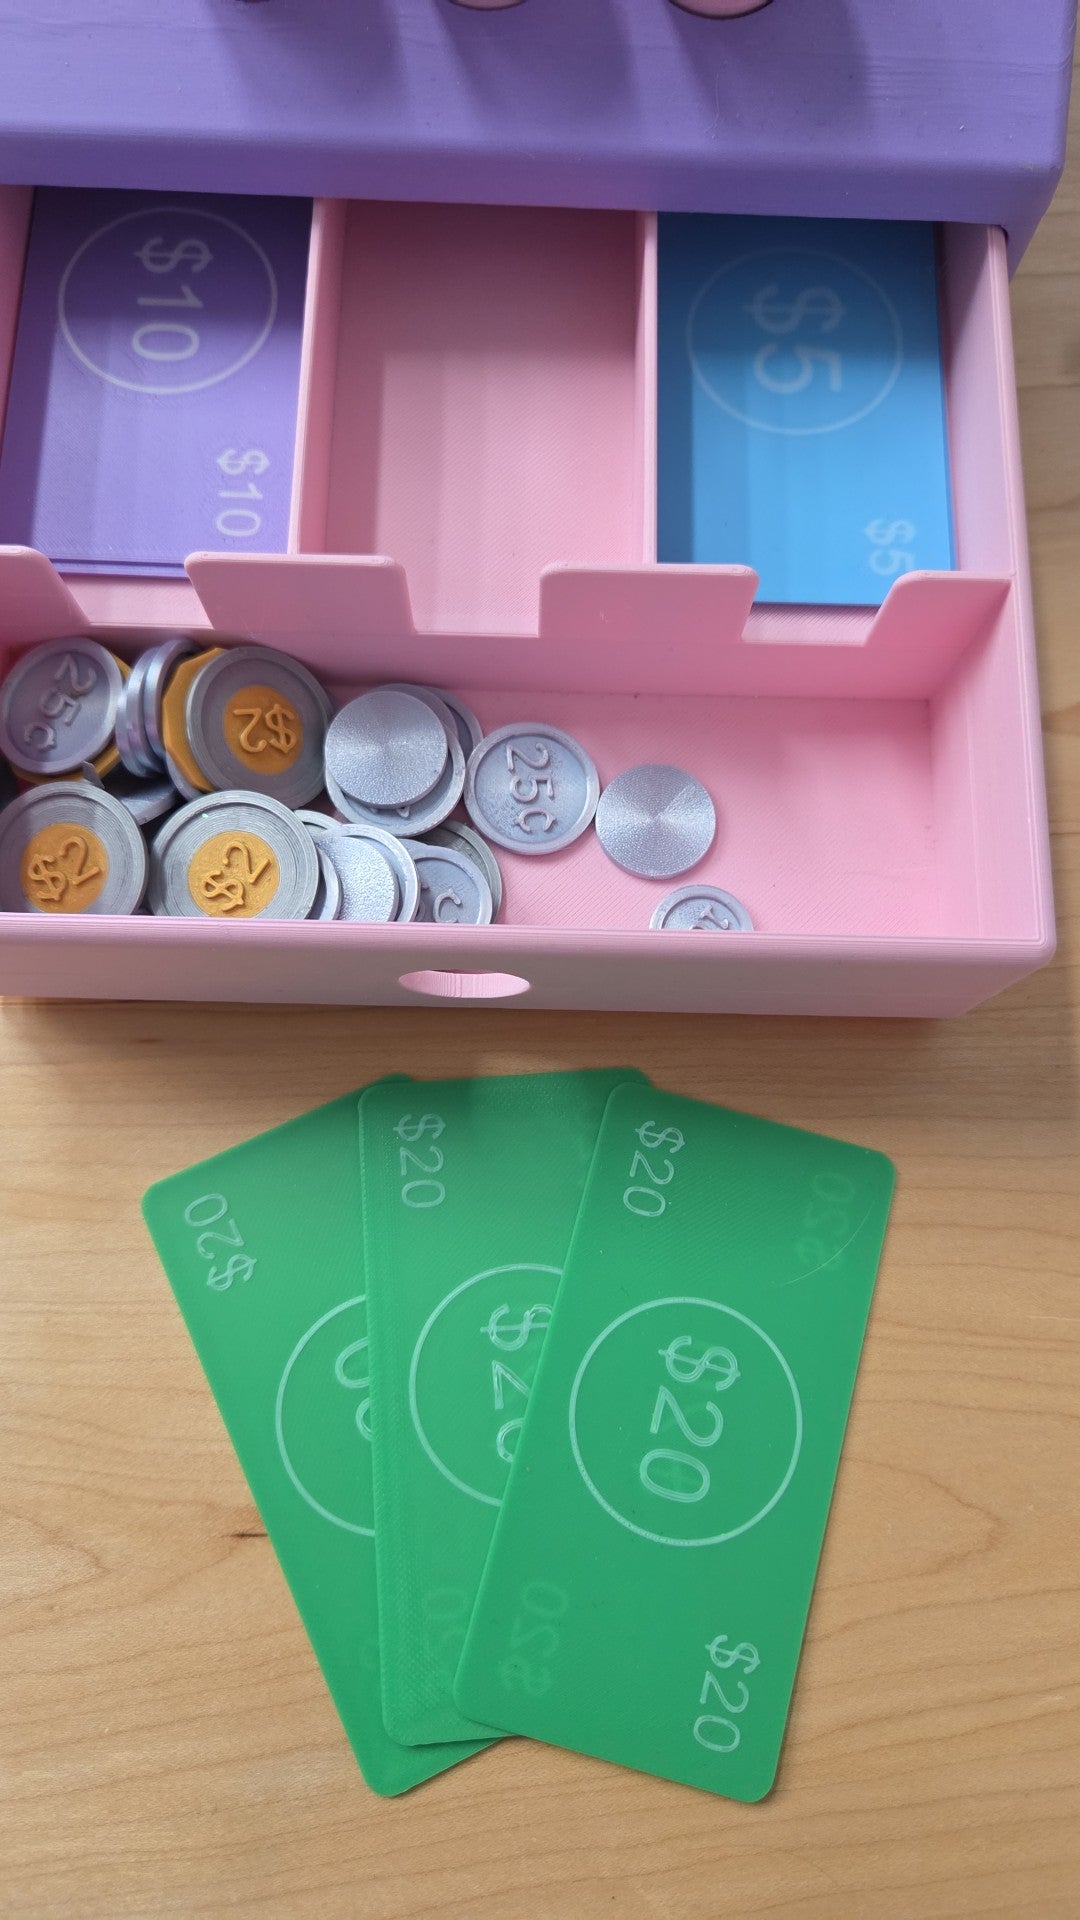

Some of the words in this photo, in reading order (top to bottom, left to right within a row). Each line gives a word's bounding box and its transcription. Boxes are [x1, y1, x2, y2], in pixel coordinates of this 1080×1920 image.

[132, 236, 213, 362] $10
[745, 283, 846, 394] $5
[215, 448, 270, 537] $10
[864, 518, 916, 575] $5
[24, 653, 97, 750] 25¢
[233, 703, 297, 753] $2
[506, 743, 558, 834] 25¢
[27, 835, 102, 903] $2
[203, 841, 271, 914] $2
[393, 1113, 446, 1209] $20
[623, 1120, 685, 1217] $20
[184, 1192, 257, 1291] $20
[640, 1335, 741, 1503] $20
[693, 1634, 761, 1753] $20
